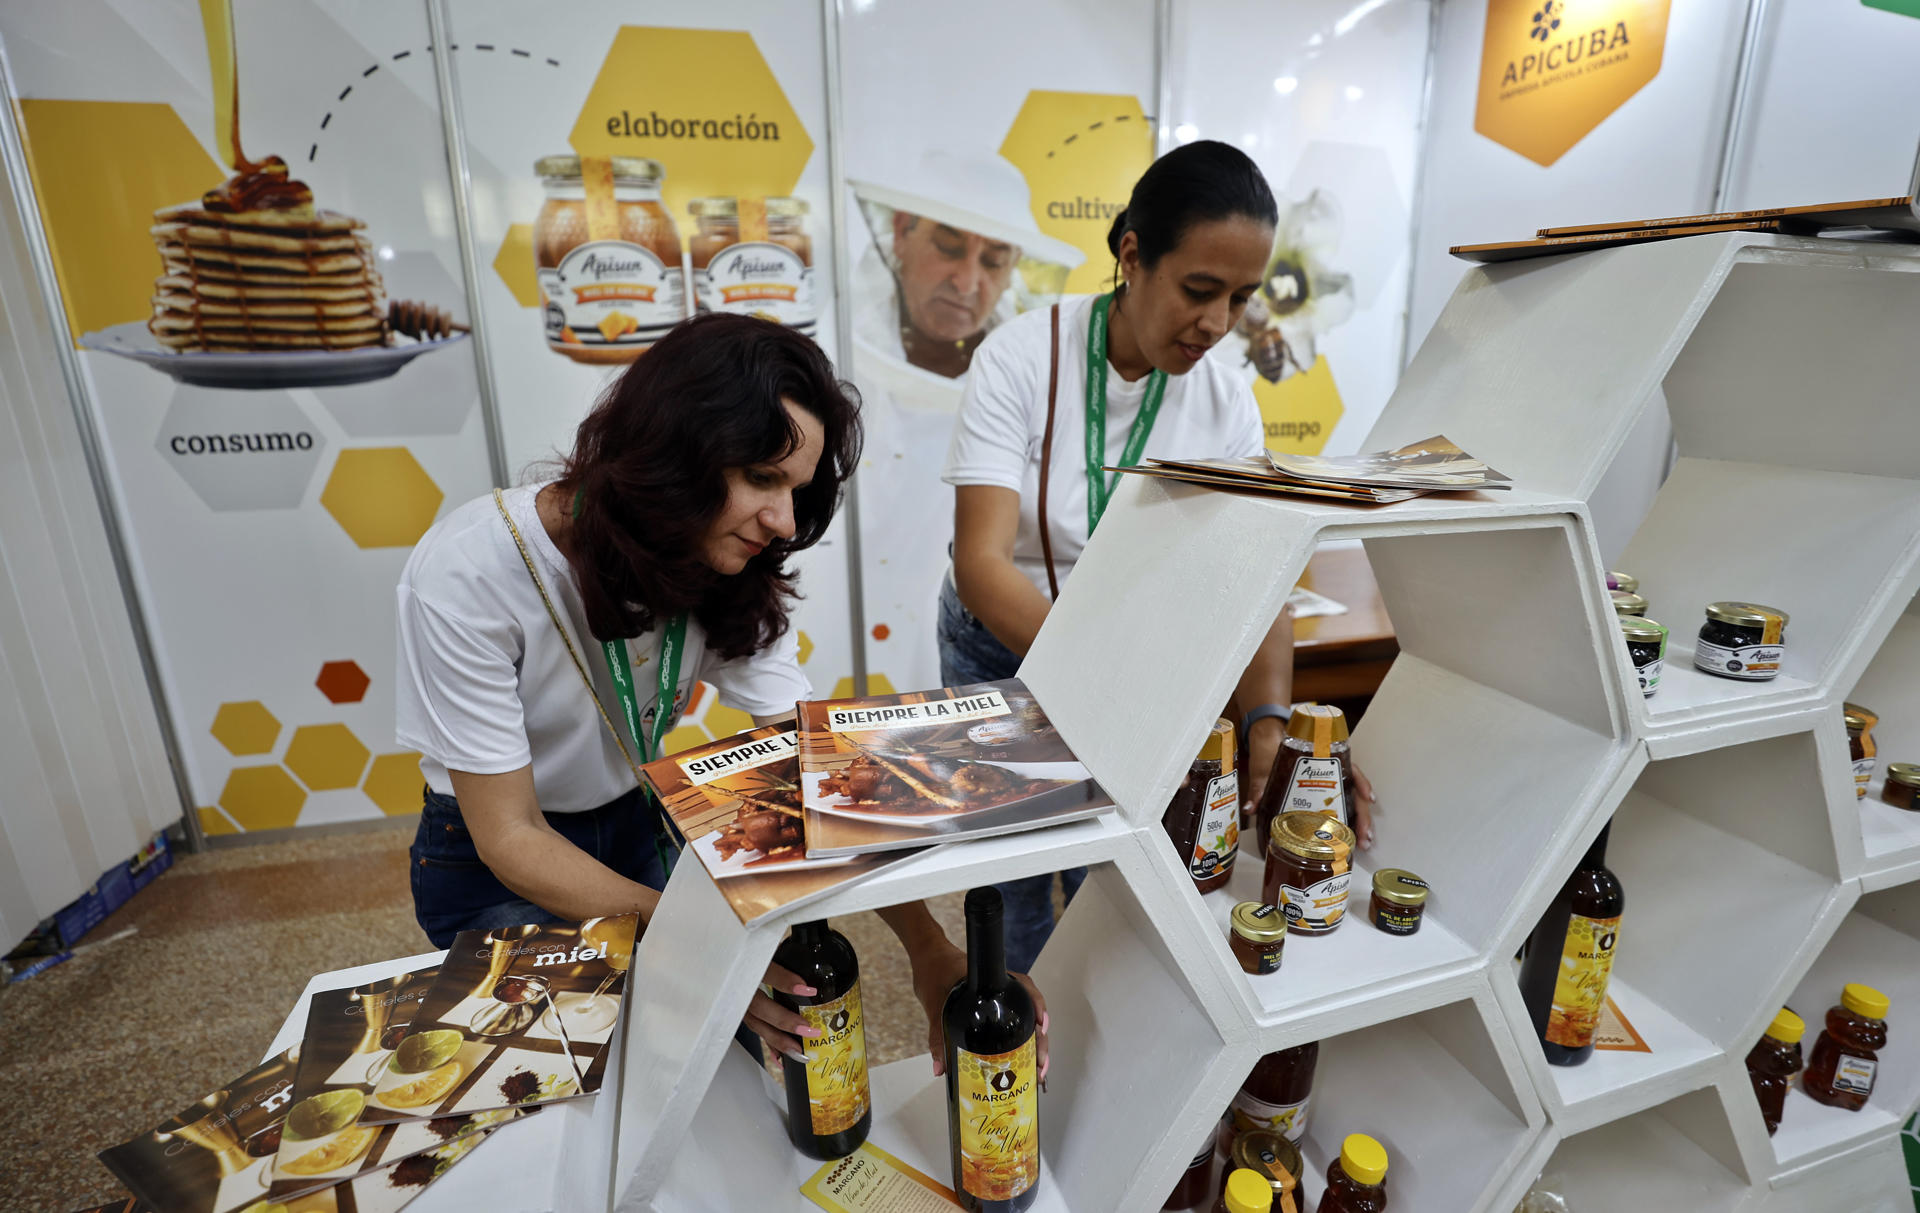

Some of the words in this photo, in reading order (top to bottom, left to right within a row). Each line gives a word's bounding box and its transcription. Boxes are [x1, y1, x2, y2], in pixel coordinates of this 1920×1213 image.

[1501, 22, 1629, 87] APICUBA
[606, 110, 780, 140] elaboración
[581, 254, 642, 280] Apisun
[728, 255, 785, 280] Apisun
[170, 431, 313, 455] consumo
[1264, 421, 1322, 442] ampo
[835, 706, 920, 724] SIEMPRE
[924, 703, 949, 717] LA
[954, 696, 1001, 713] MIEL
[689, 739, 781, 775] SIEMPRE
[781, 733, 797, 747] L
[1301, 766, 1334, 779] Apisun
[1293, 797, 1311, 809] 500g
[1207, 820, 1223, 832] 500g
[533, 941, 608, 967] miel
[538, 943, 566, 953] con
[809, 1016, 860, 1048] MARCANO
[254, 1079, 290, 1103] con
[972, 1082, 1030, 1103] MARCANO
[970, 1111, 1009, 1136] Vino
[980, 1138, 993, 1151] de
[989, 1119, 1032, 1154] Miel
[833, 1159, 865, 1196] MARCANO
